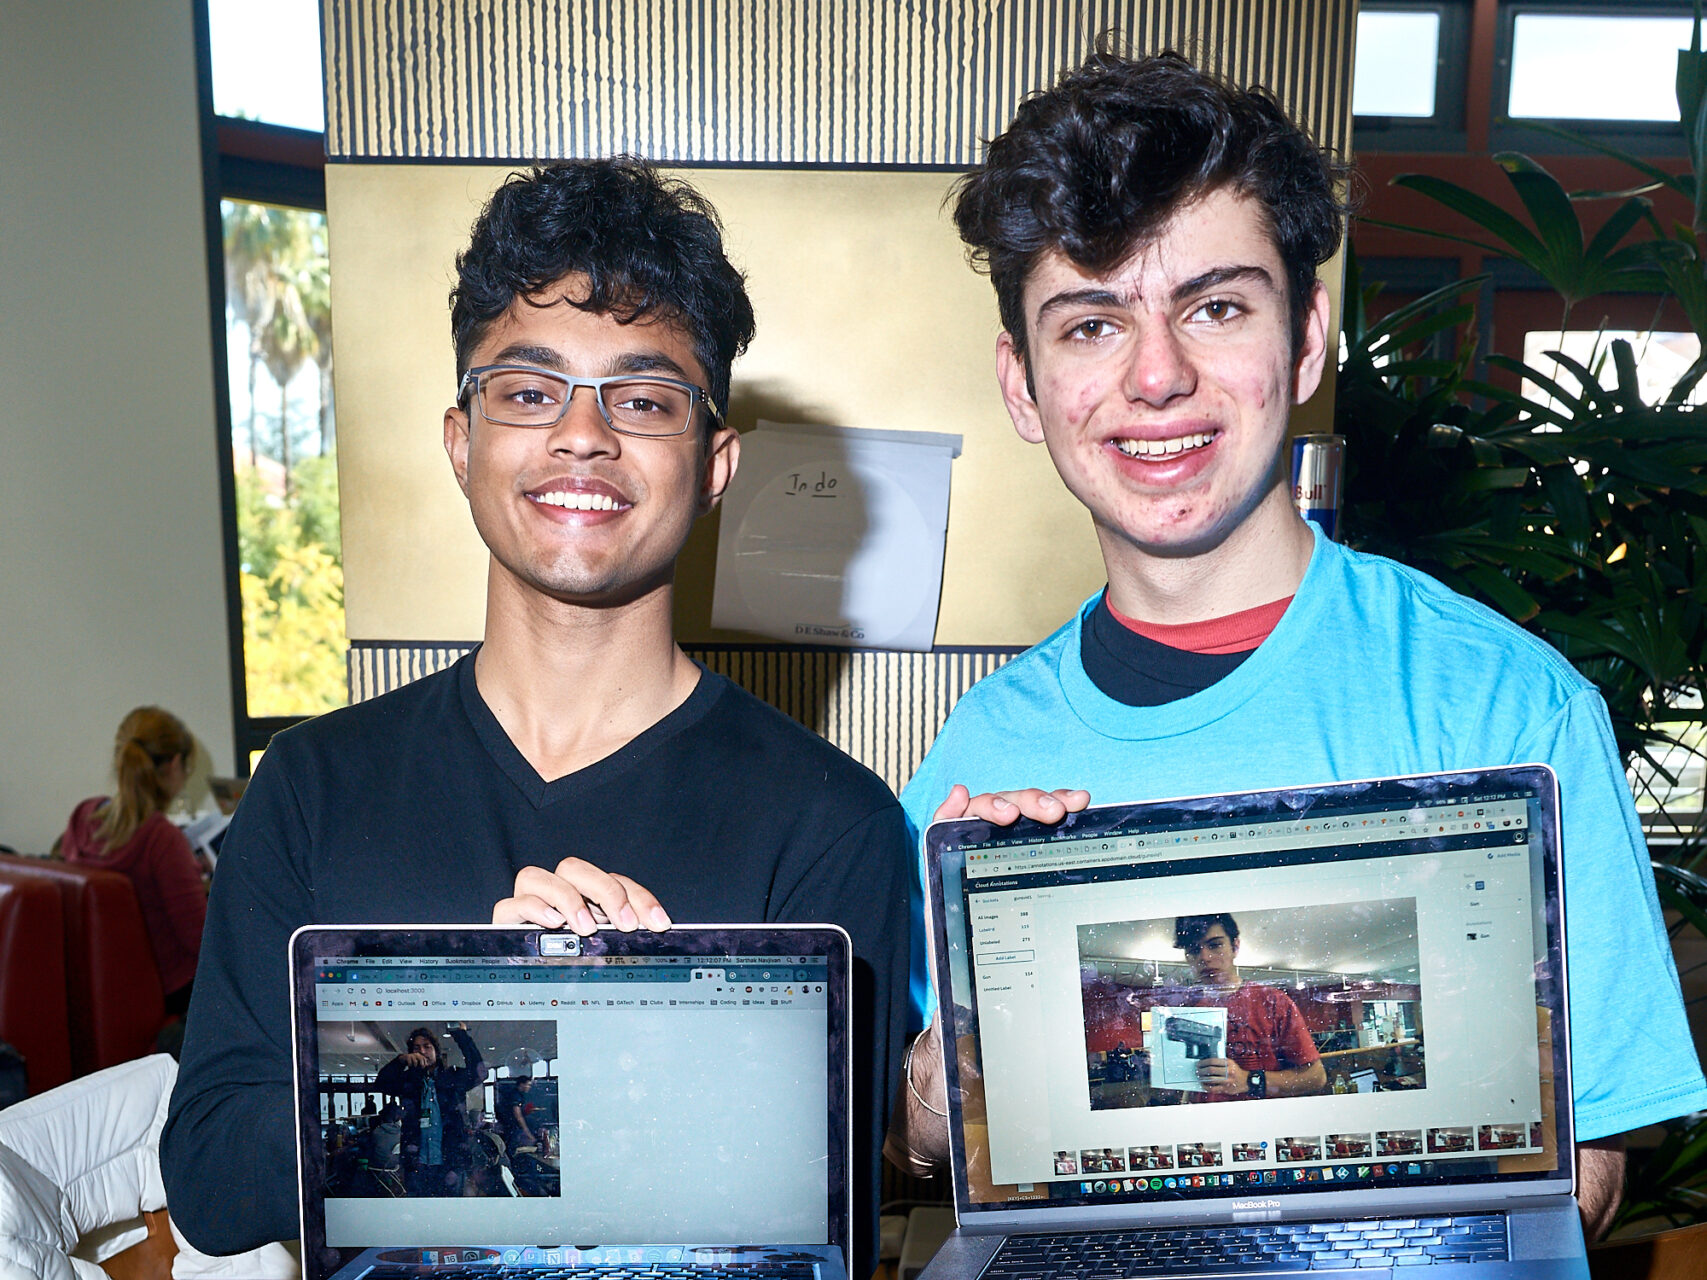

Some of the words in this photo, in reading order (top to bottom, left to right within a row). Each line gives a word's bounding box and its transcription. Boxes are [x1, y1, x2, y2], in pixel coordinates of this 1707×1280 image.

[815, 471, 837, 492] do
[1295, 484, 1322, 500] Bull
[975, 881, 989, 889] Cloud
[990, 880, 1018, 888] Annotations
[1232, 1201, 1267, 1210] MacBook
[1268, 1200, 1281, 1208] Pro
